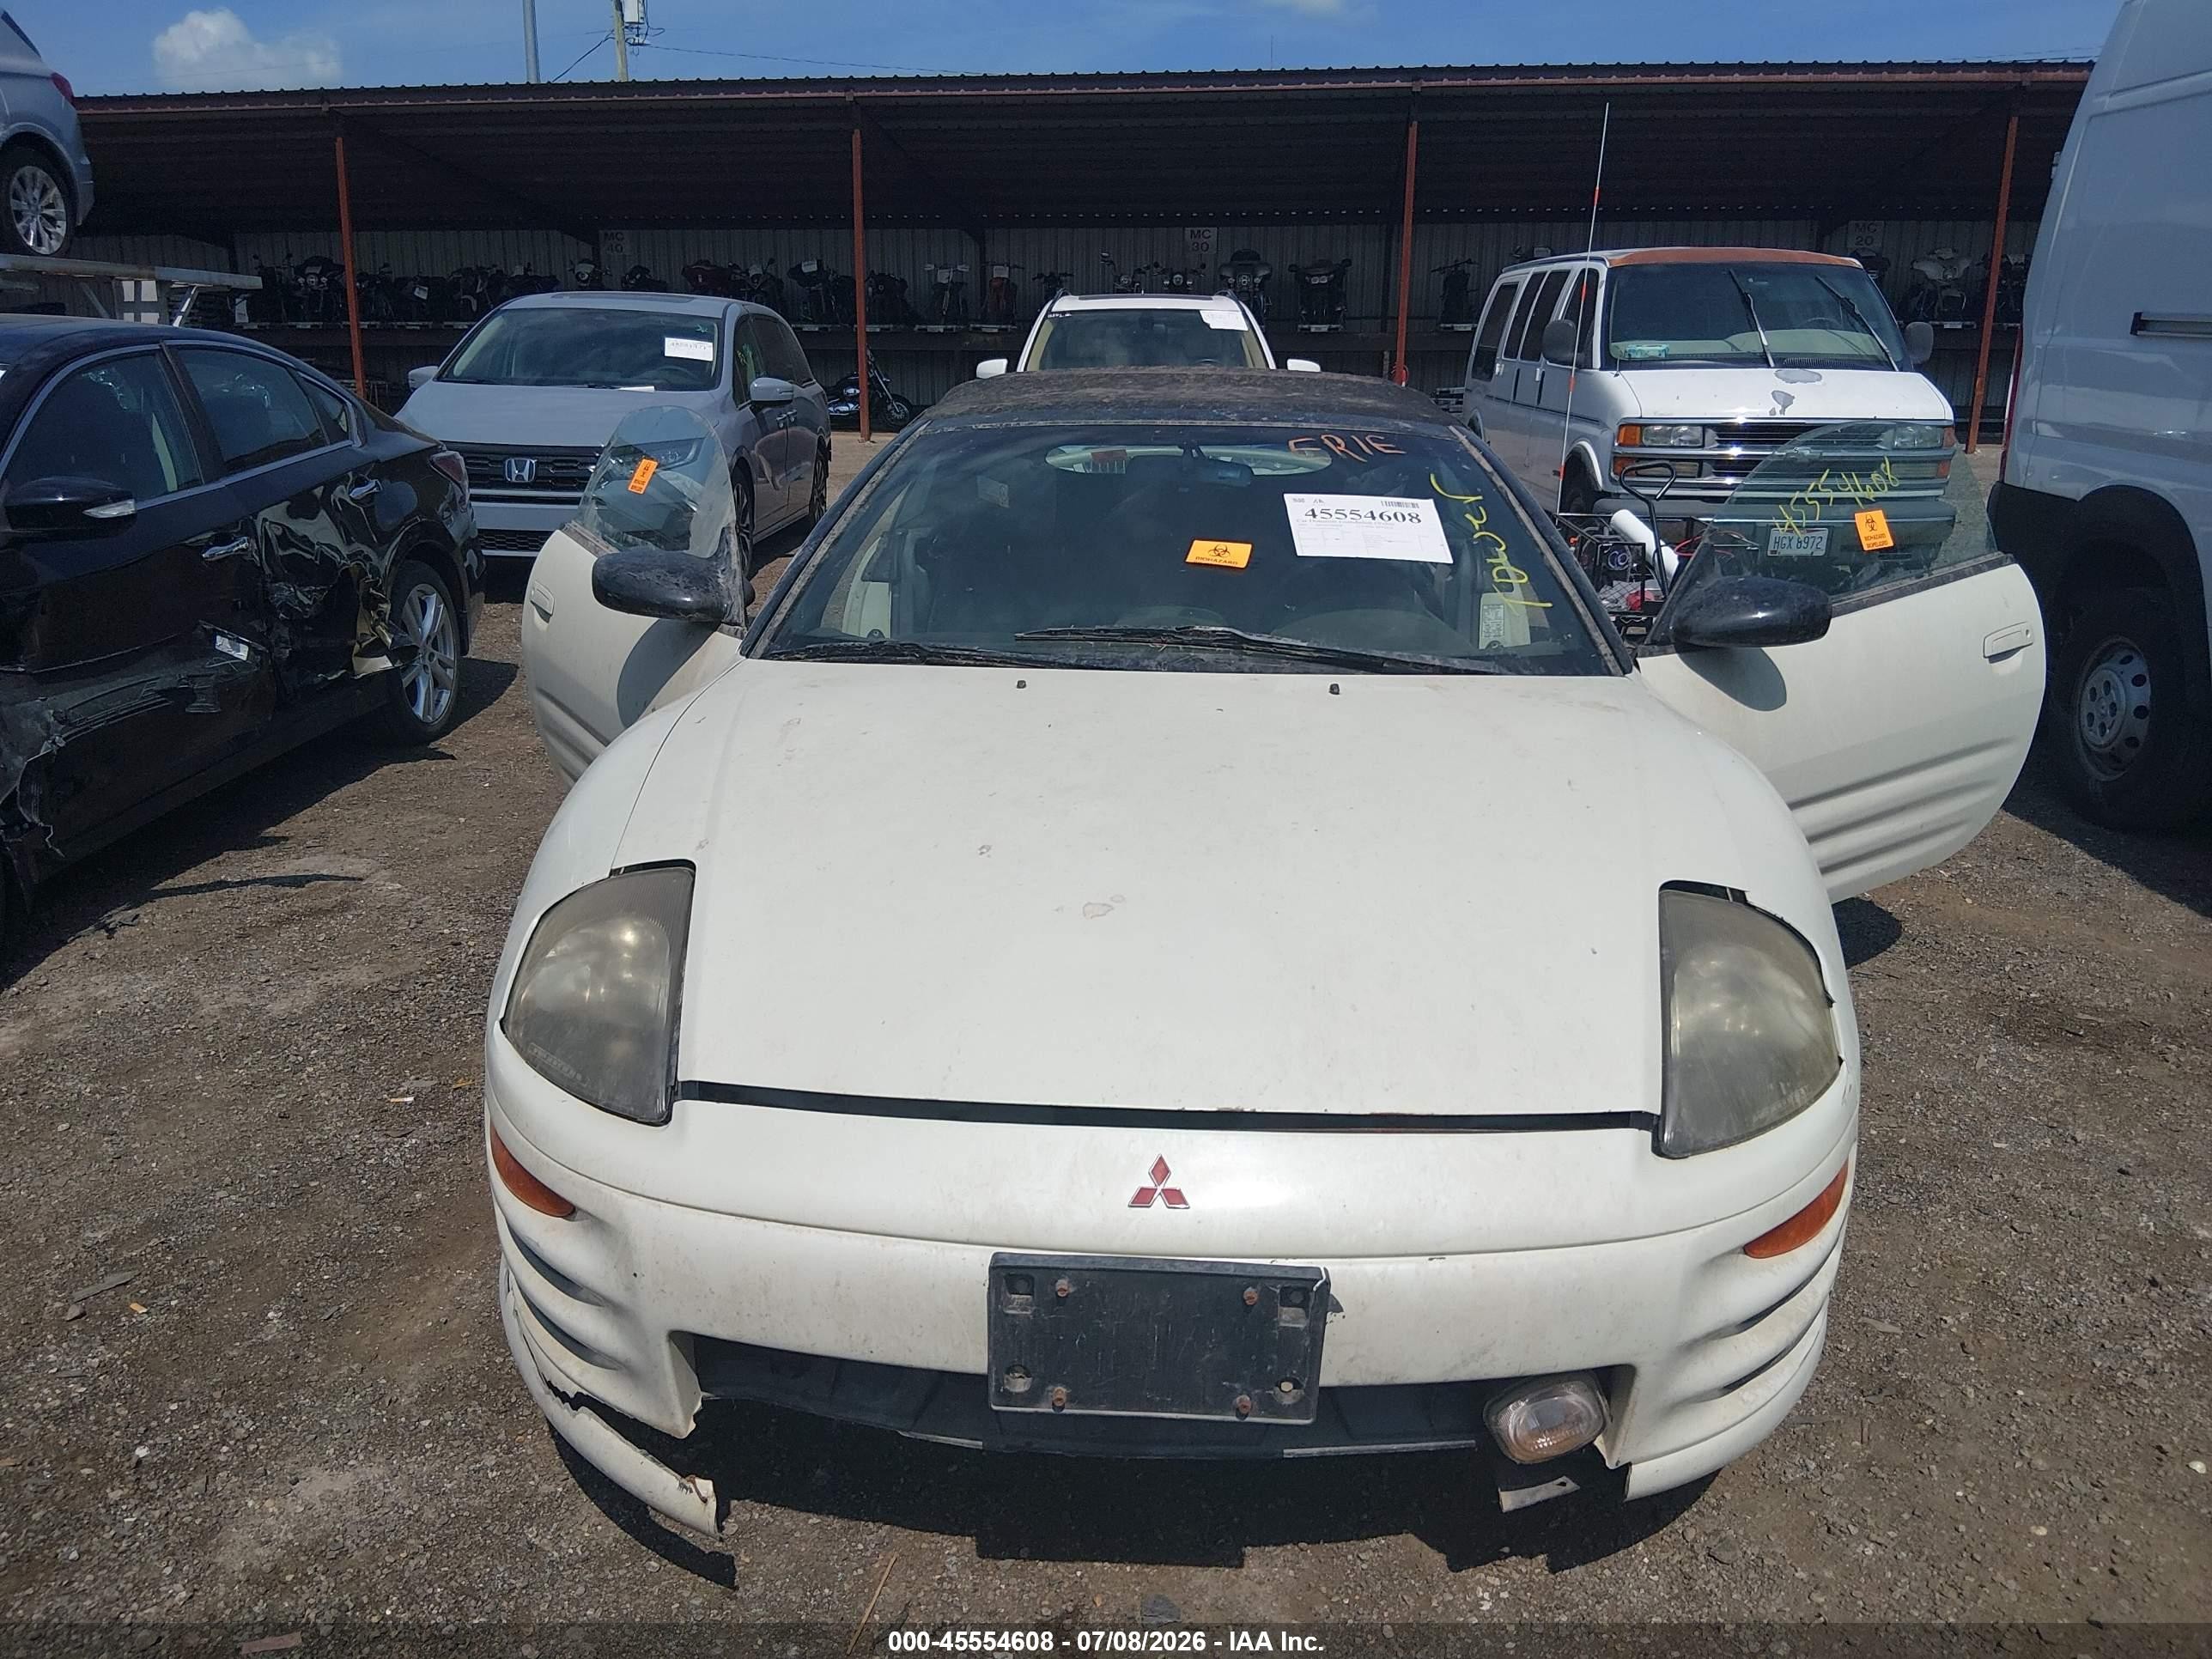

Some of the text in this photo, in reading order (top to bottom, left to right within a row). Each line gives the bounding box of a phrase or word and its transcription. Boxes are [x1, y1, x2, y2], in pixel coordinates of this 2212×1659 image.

[1189, 228, 1212, 240] MC
[1855, 222, 1877, 234] MC
[1191, 241, 1210, 252] 30
[1855, 235, 1875, 246] 20
[1288, 433, 1407, 463] ERIE
[1304, 507, 1422, 525] 45554608
[1773, 536, 1823, 550] HGX 8972
[1195, 556, 1239, 565] BIOHAZARD
